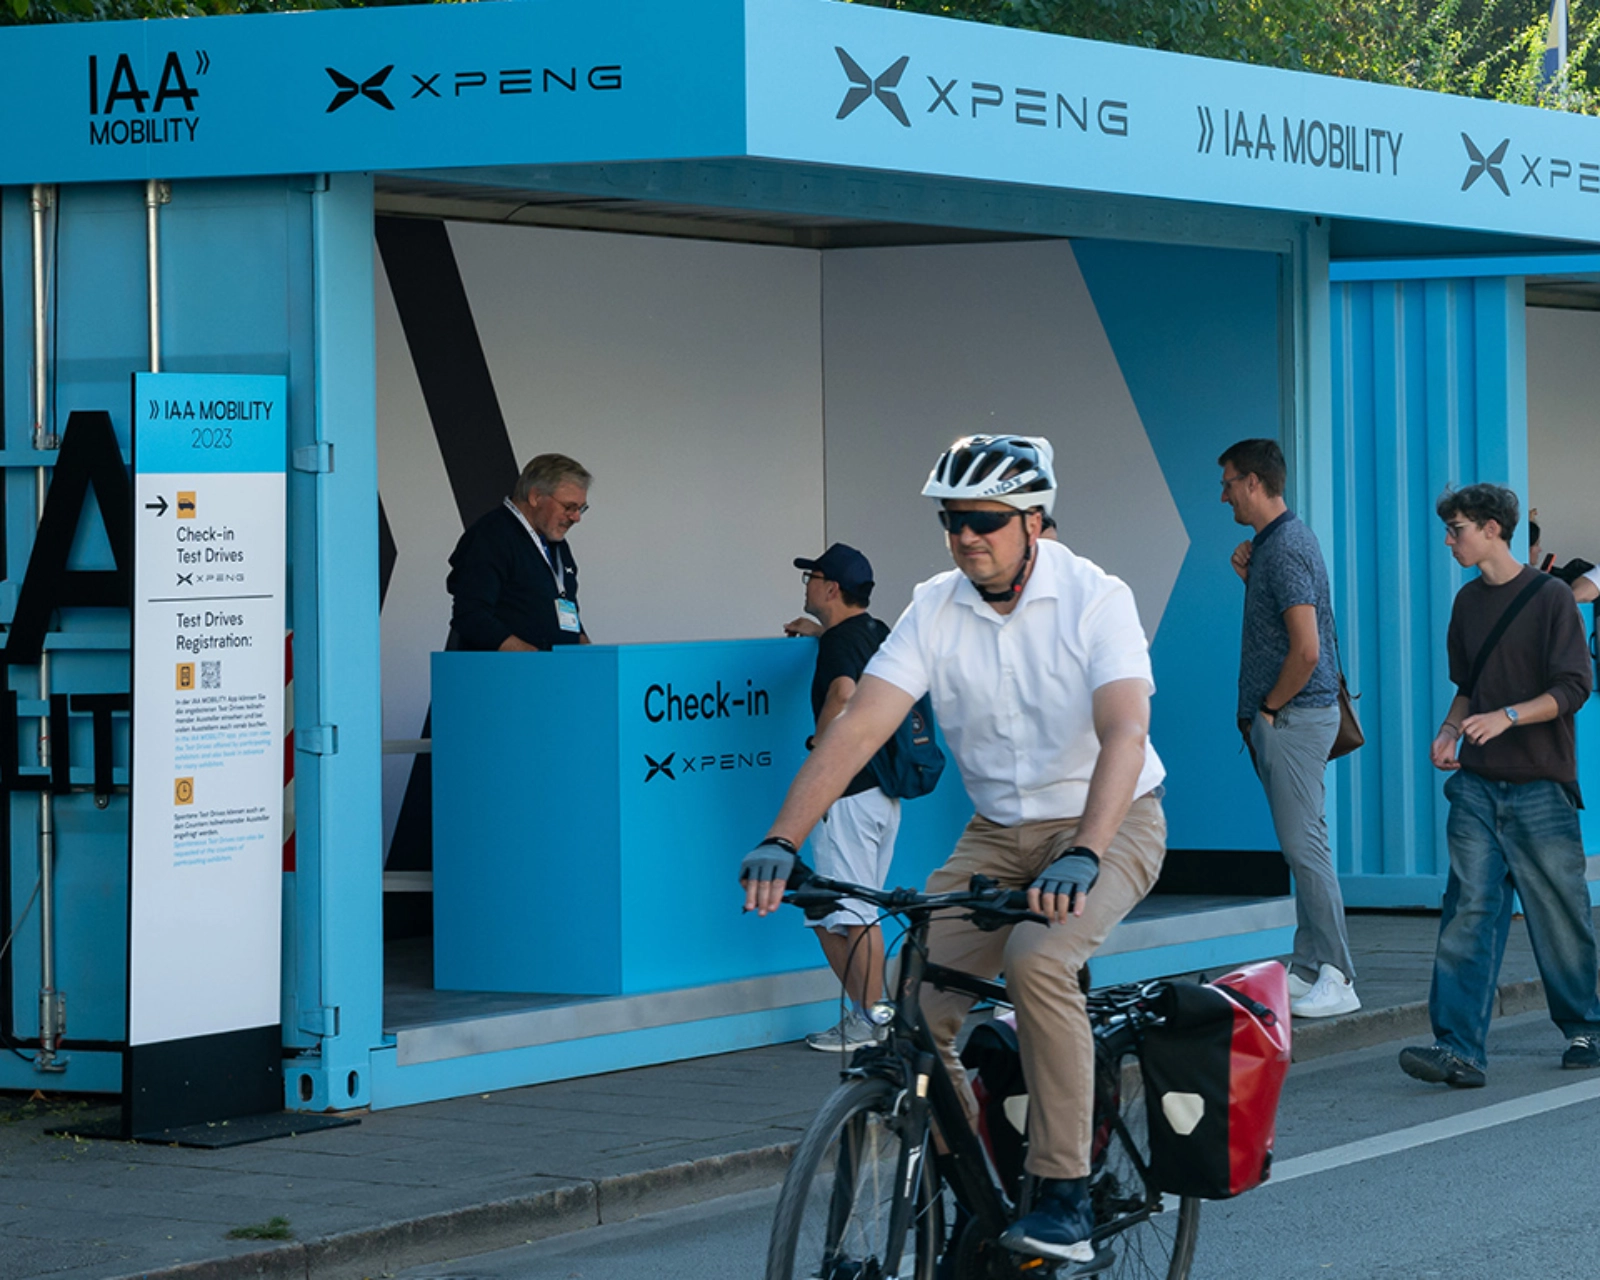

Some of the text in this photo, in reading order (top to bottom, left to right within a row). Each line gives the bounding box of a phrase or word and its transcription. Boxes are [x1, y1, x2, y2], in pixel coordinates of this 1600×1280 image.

[89, 51, 199, 115] IAA
[411, 65, 622, 98] XPENG
[926, 76, 1129, 136] XPENG
[90, 117, 200, 145] MOBILITY
[1224, 108, 1403, 176] IAA MOBILITY
[165, 400, 274, 420] IAA MOBILITY
[191, 427, 233, 449] 2023
[176, 526, 235, 542] Check-in
[177, 547, 244, 563] Test Drives
[196, 573, 245, 582] XPENG
[177, 611, 244, 628] Test Drives
[176, 633, 253, 654] Registration:
[644, 678, 769, 723] Check-in
[682, 751, 773, 774] XPENG
